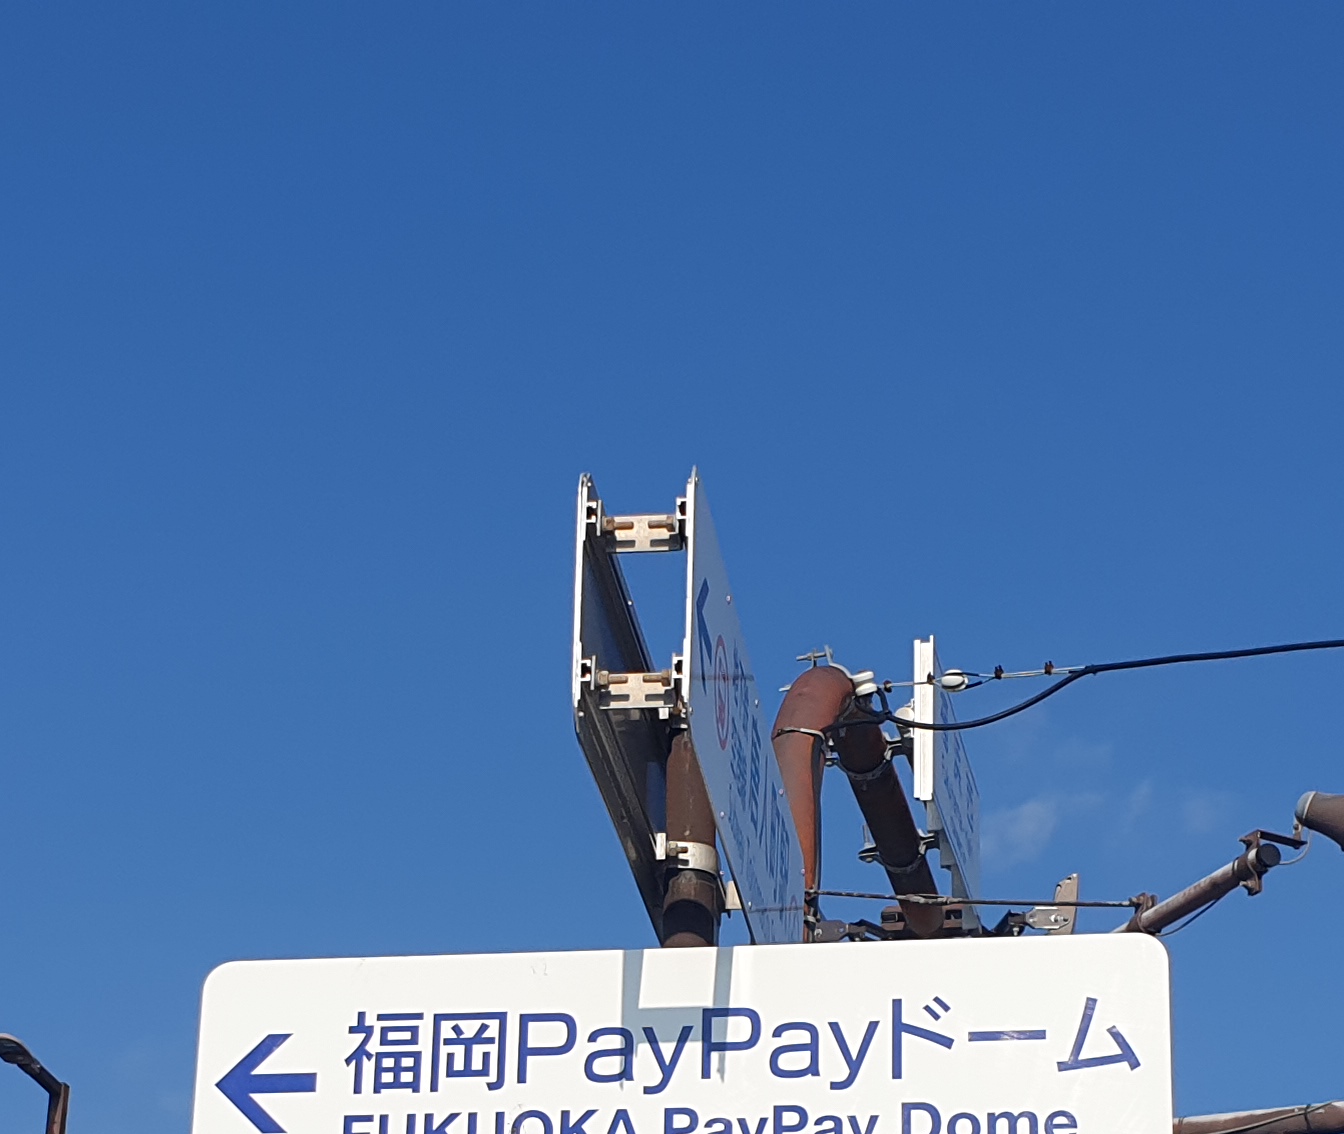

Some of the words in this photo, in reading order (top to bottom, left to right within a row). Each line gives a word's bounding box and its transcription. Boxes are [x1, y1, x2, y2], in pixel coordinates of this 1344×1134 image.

[341, 996, 1141, 1095] 福岡PayPayドーム
